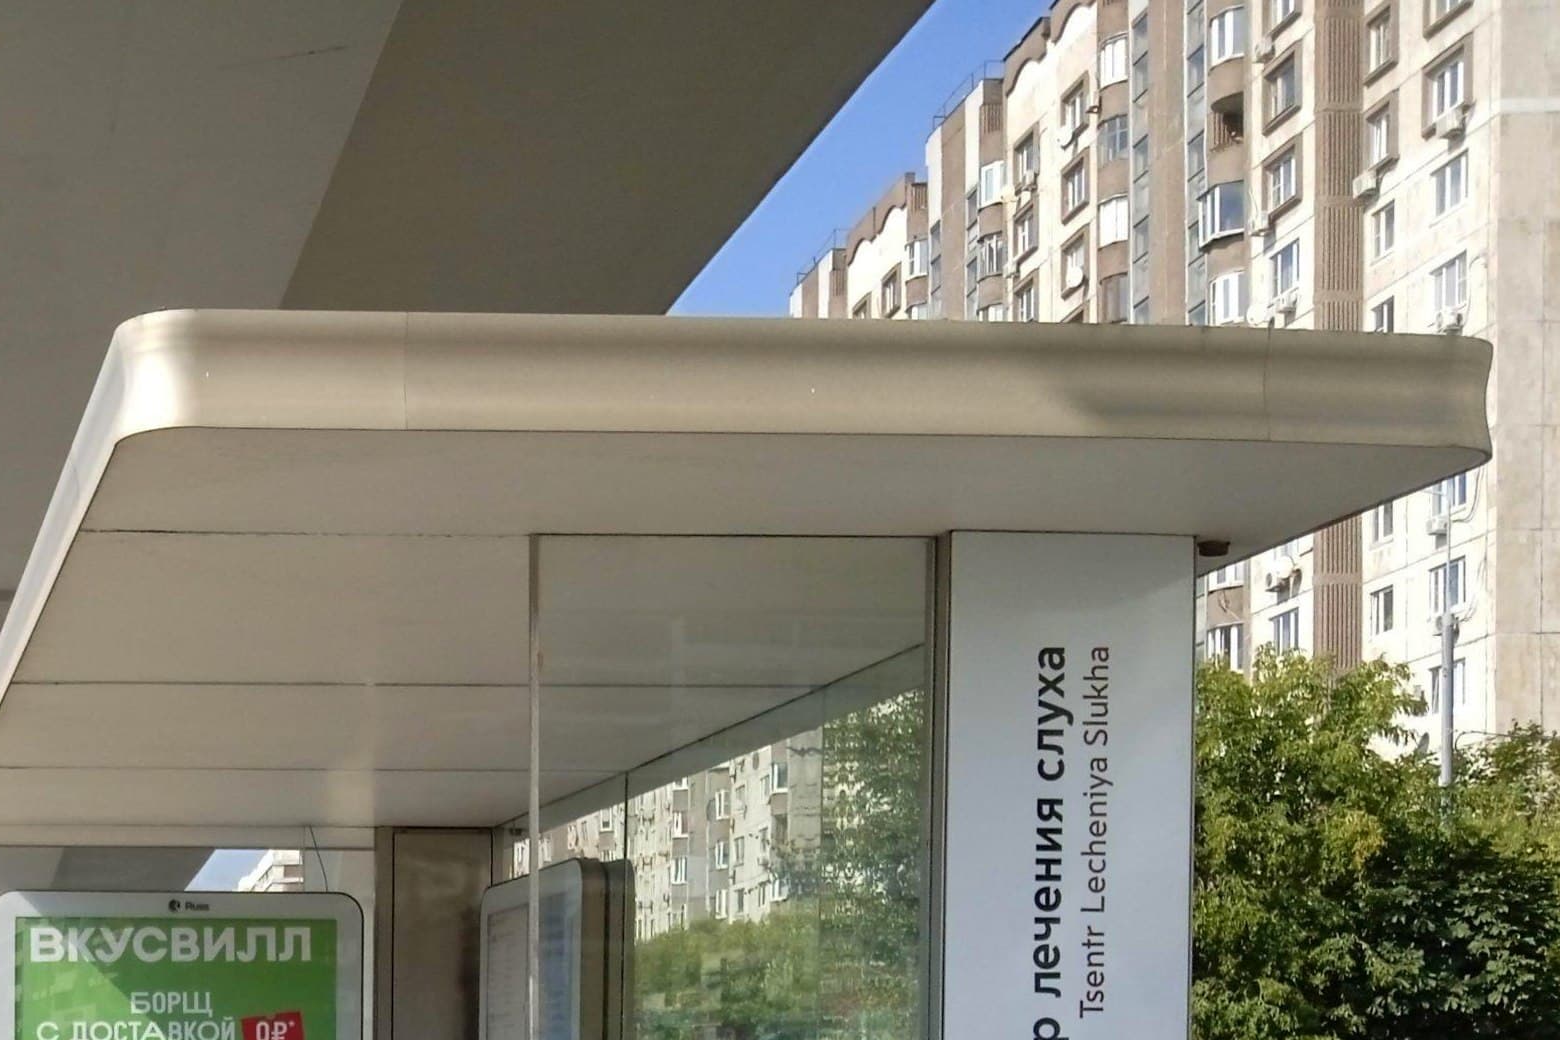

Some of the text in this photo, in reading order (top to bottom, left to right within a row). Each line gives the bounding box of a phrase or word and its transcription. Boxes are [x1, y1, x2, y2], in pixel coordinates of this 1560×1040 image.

[1037, 646, 1074, 782] слуха
[1032, 797, 1064, 998] лечения
[1079, 646, 1114, 1019] Tsentr Lecheniya Slukha
[30, 927, 312, 963] ВКУСВИЛЛ
[130, 992, 213, 1017] БОРЩ
